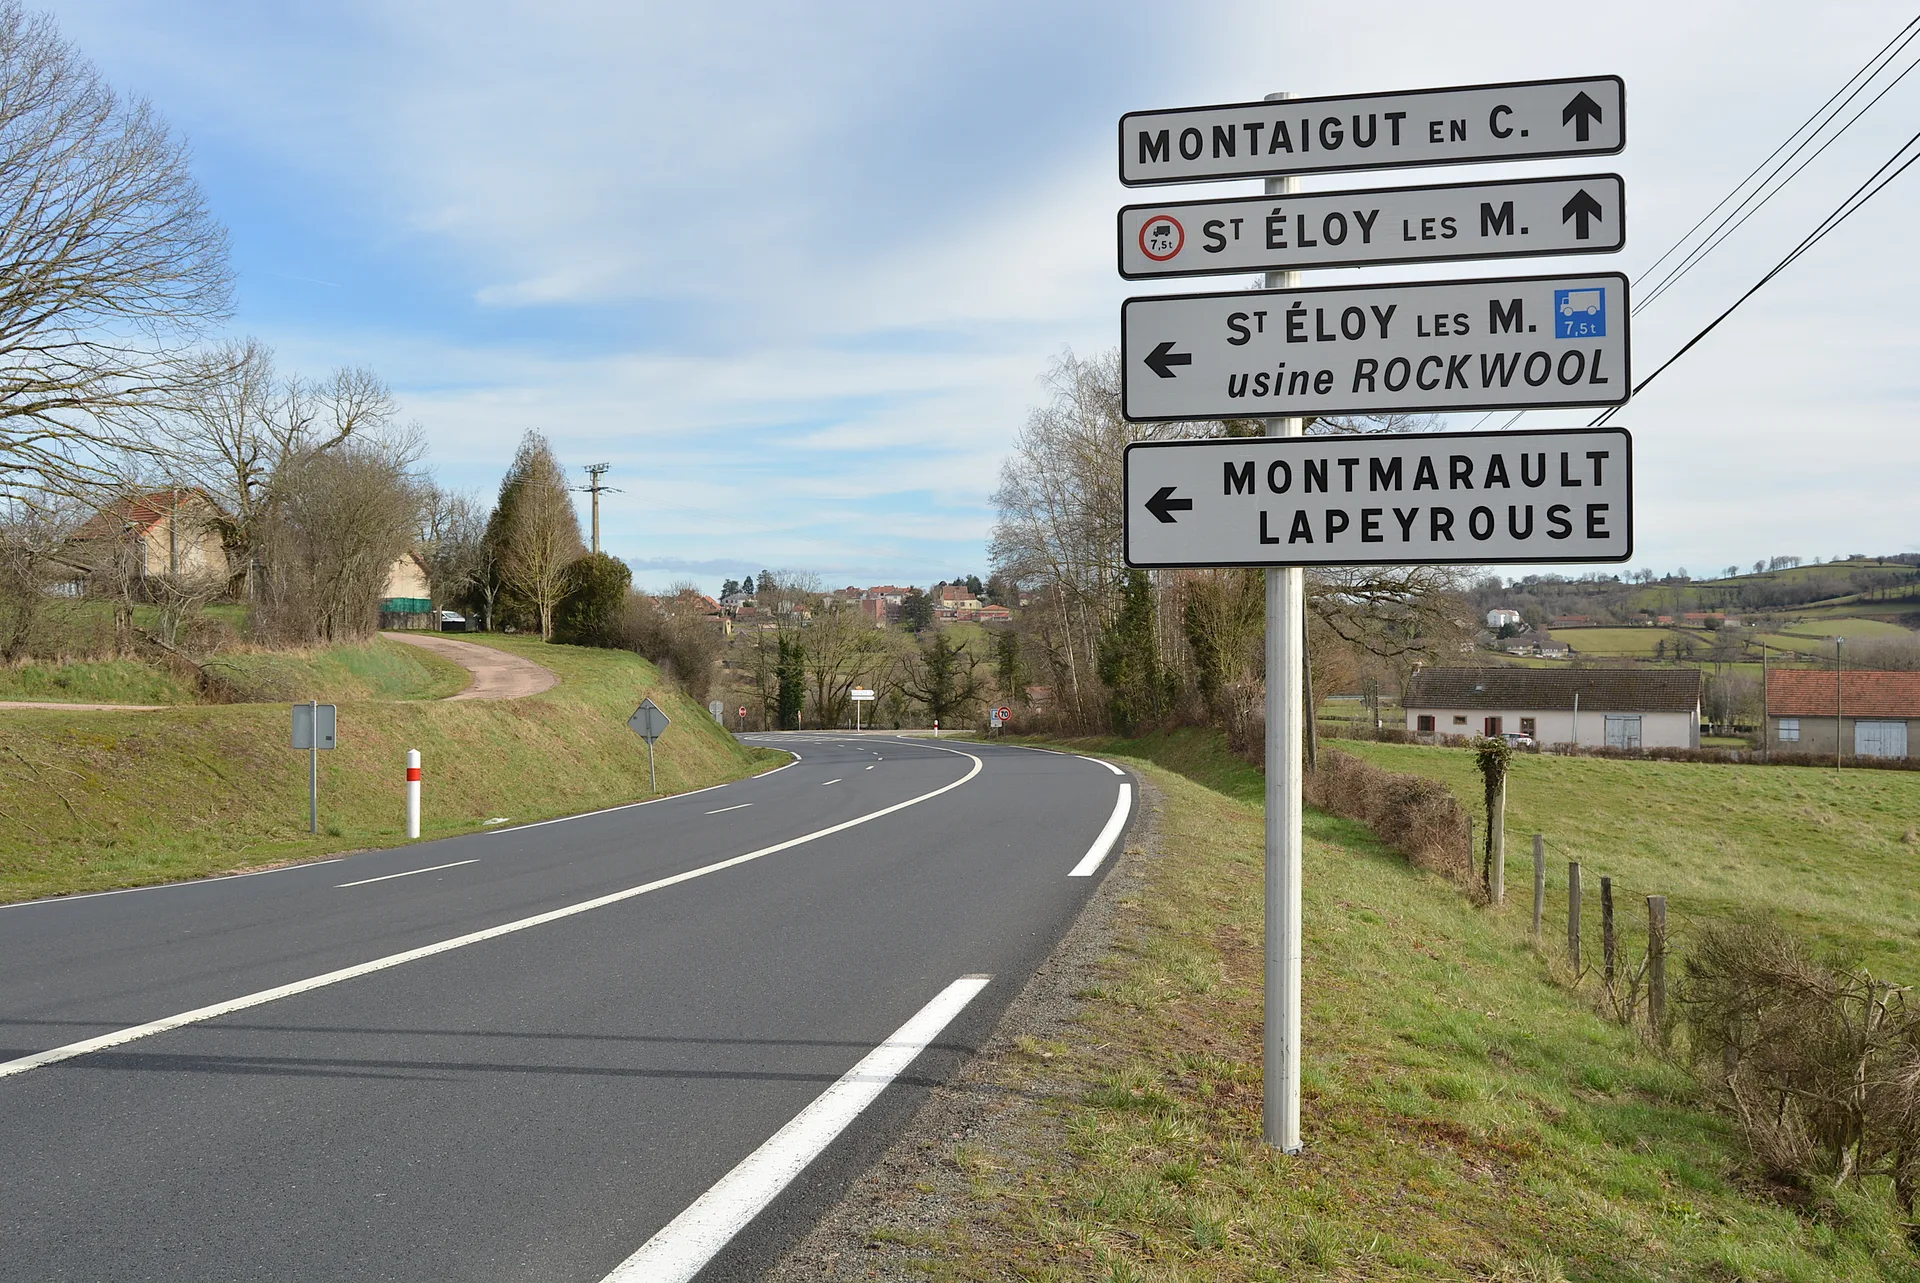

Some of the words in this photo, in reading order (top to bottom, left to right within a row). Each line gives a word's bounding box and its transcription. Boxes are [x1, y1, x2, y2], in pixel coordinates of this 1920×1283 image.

[1138, 112, 1407, 165] MONTAIGUT
[1429, 118, 1467, 144] EN
[1489, 104, 1529, 139] C.
[1202, 216, 1244, 254] ST
[1266, 207, 1380, 250] ÉLOY
[1403, 216, 1458, 242] LES
[1480, 200, 1529, 238] M.
[1226, 311, 1268, 346] ST
[1285, 300, 1398, 343] ÉLOY
[1417, 313, 1470, 338] LES
[1489, 298, 1537, 335] M.
[1227, 361, 1335, 399] usine
[1351, 348, 1609, 394] ROCKWOOL
[1223, 450, 1610, 496] MONTMARAULT
[1259, 503, 1610, 545] LAPEYROUSE
